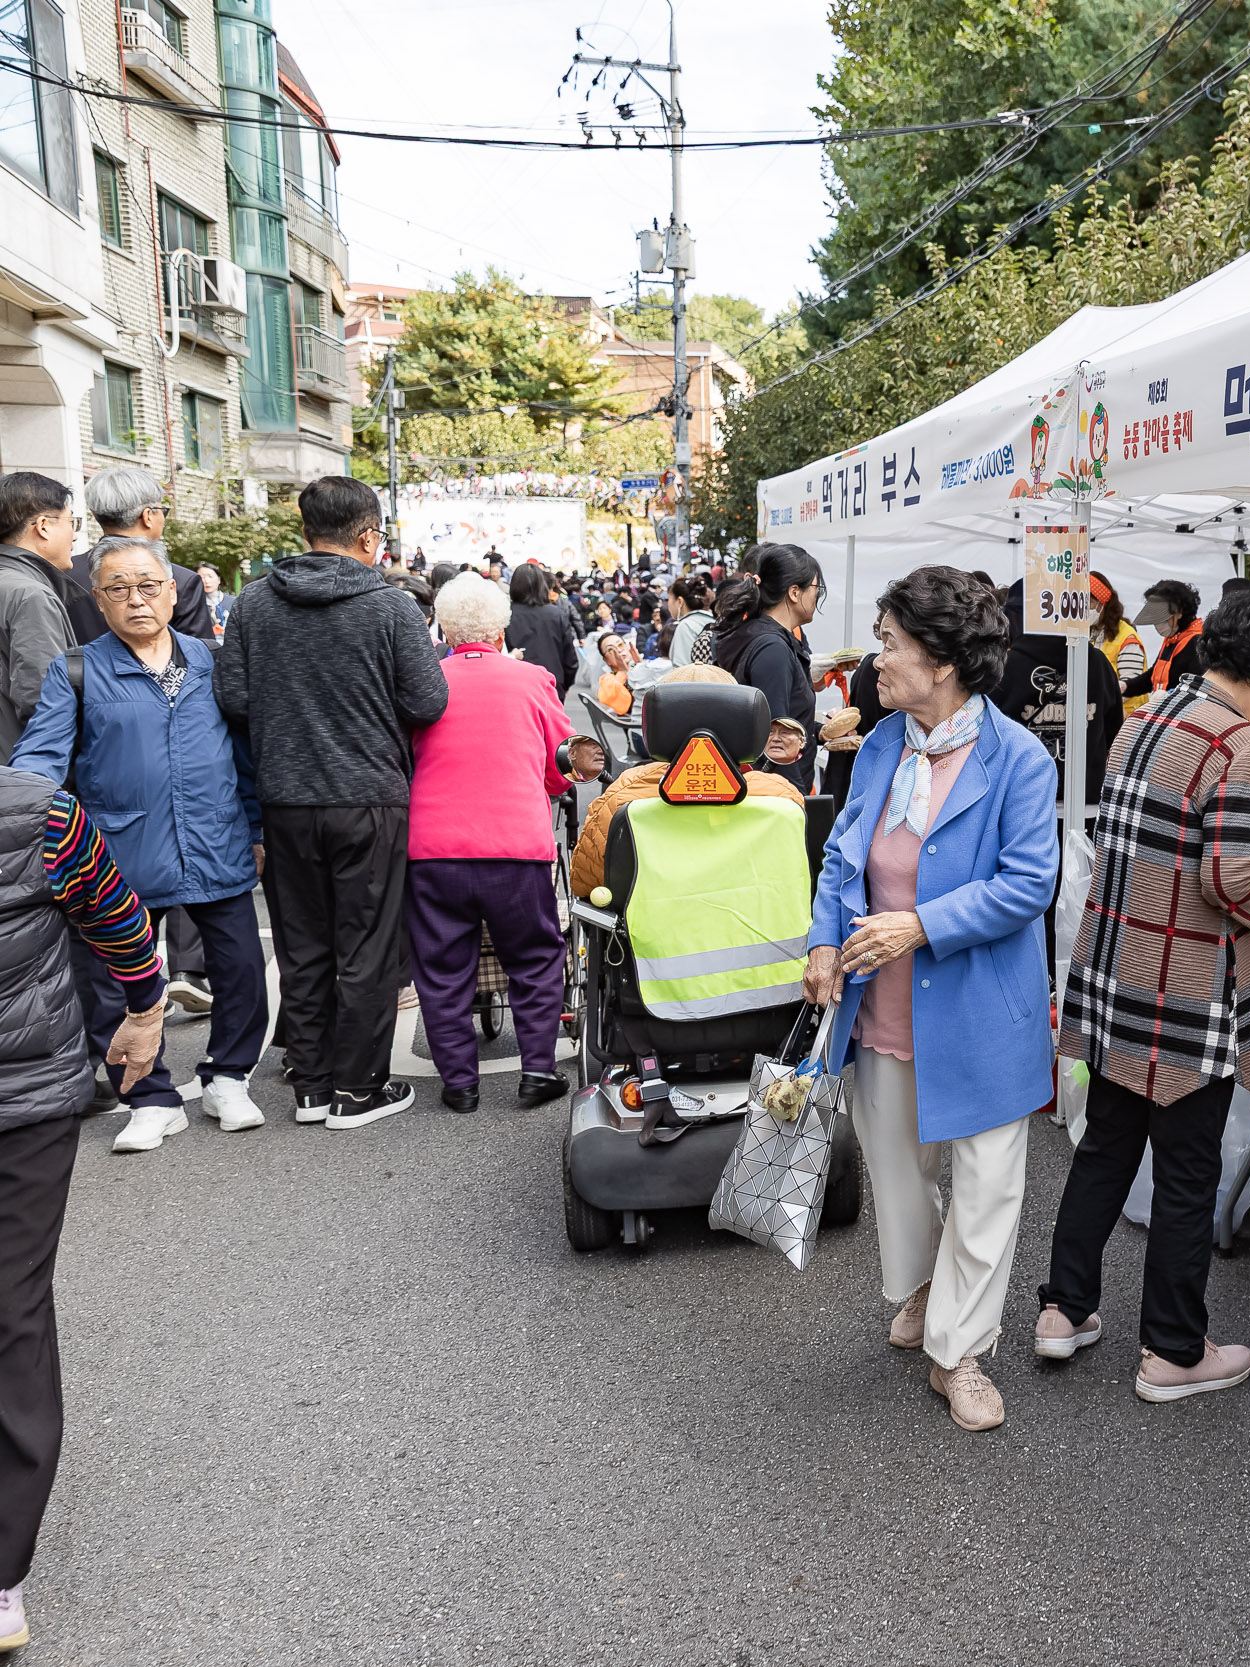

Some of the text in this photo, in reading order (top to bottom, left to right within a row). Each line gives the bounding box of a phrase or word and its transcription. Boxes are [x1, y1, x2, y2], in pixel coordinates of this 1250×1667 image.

[1148, 378, 1168, 405] 제8회
[1123, 410, 1192, 460] 능동 감마을 축제
[822, 447, 921, 523] 먹거리 부스
[1047, 550, 1073, 580] 해물
[685, 763, 717, 776] 안전
[685, 779, 717, 792] 운전
